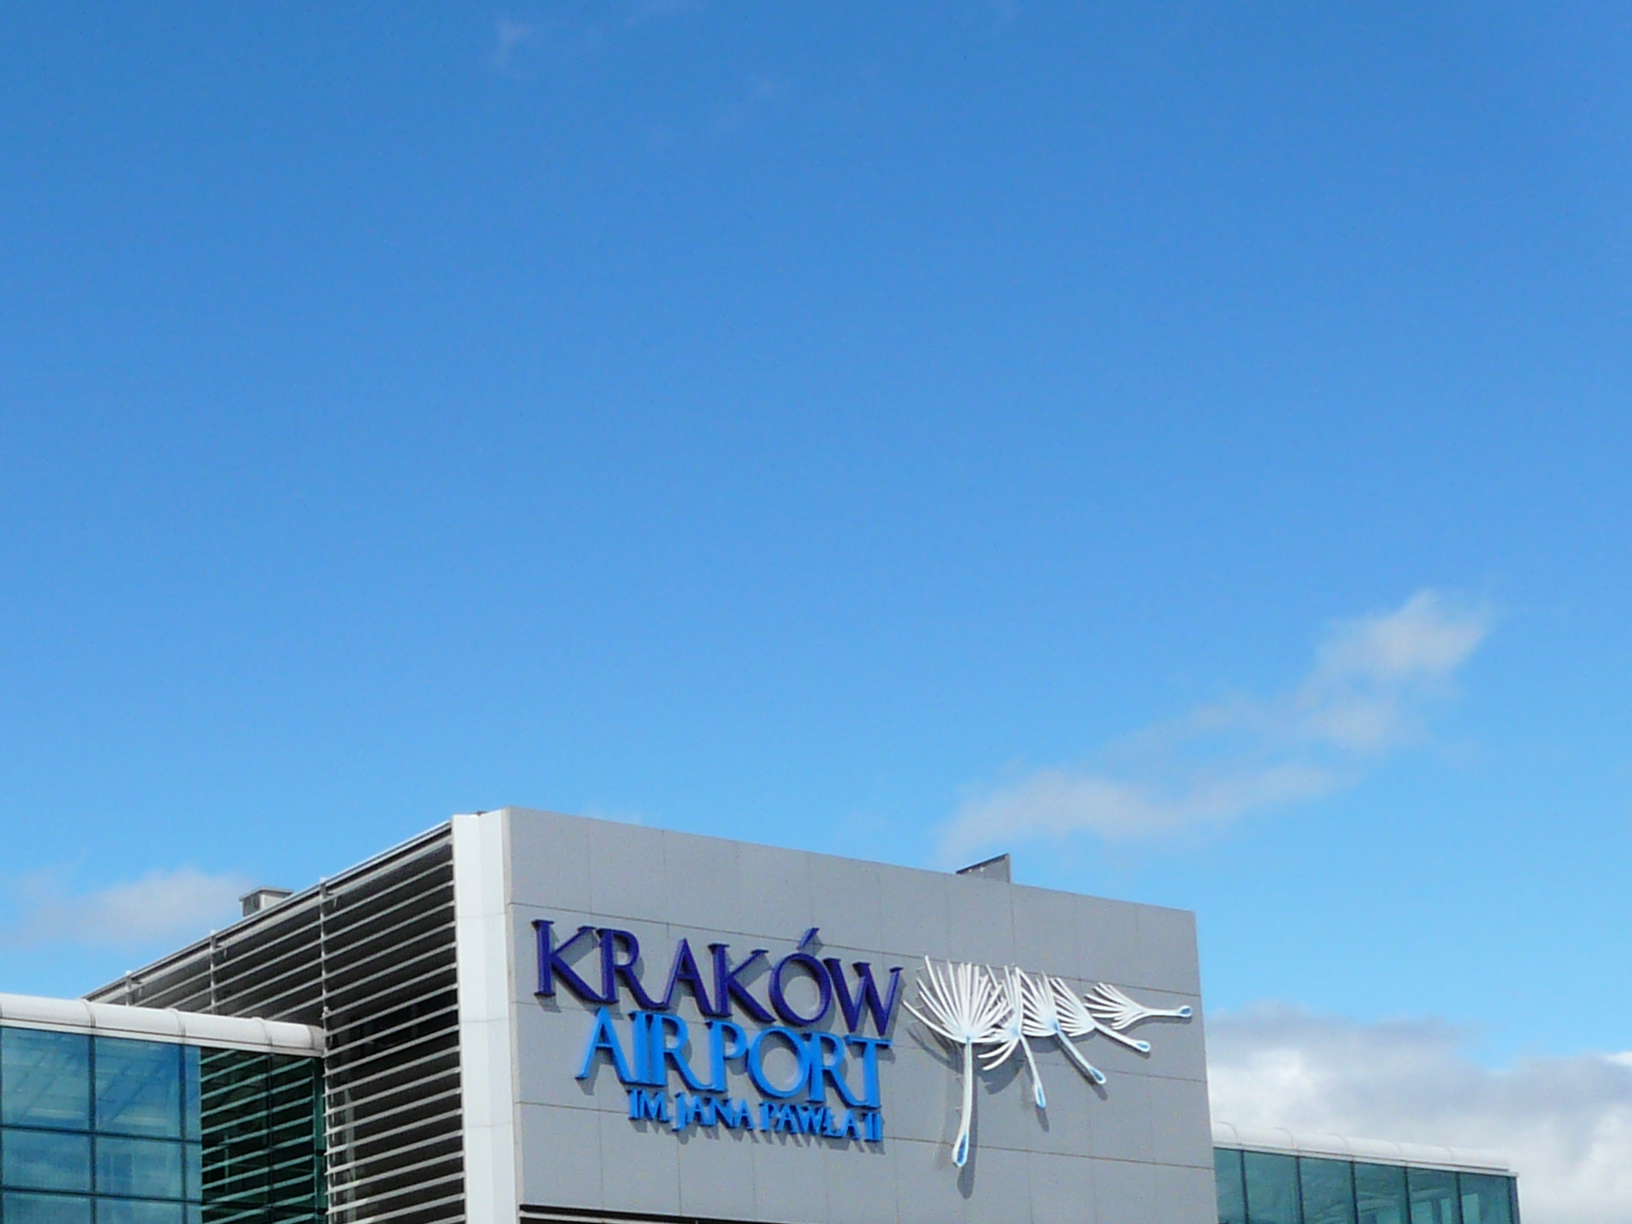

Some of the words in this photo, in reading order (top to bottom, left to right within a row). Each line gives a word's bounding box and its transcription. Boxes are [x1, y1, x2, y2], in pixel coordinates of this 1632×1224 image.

[531, 919, 903, 1037] KRAKÓW
[576, 1007, 891, 1109] AIRPORT
[672, 1091, 754, 1131] JANA
[863, 1111, 883, 1142] II
